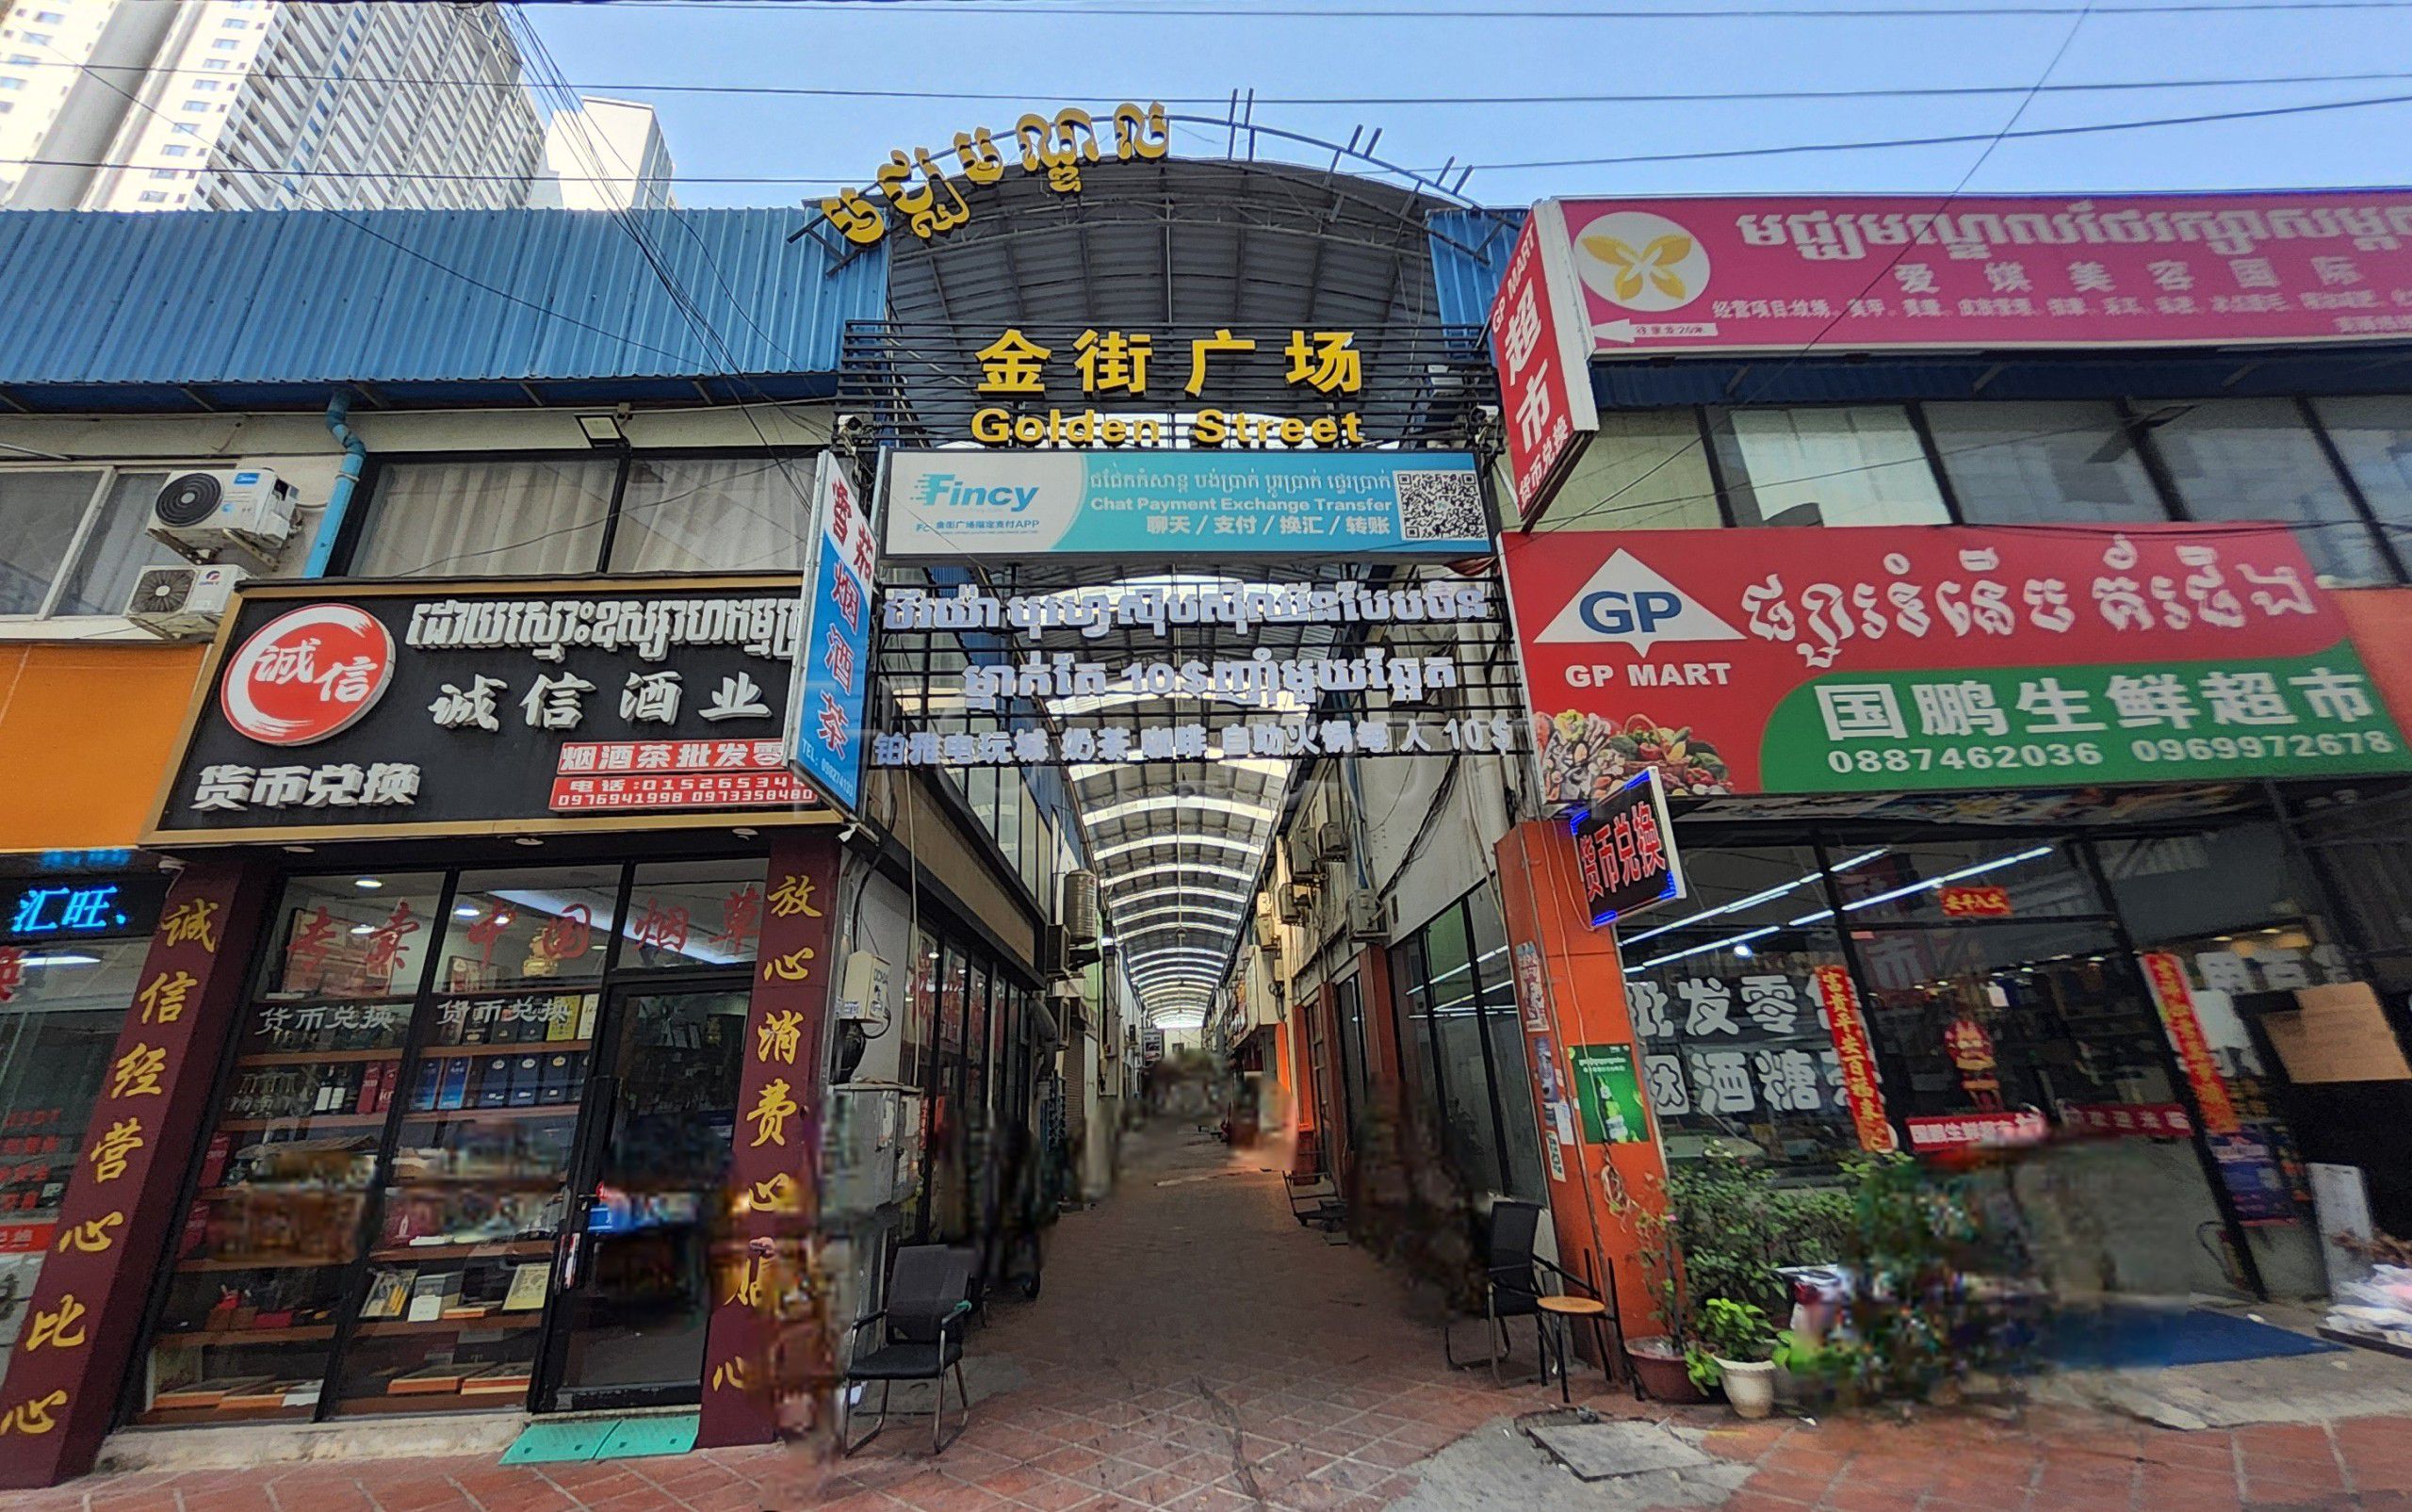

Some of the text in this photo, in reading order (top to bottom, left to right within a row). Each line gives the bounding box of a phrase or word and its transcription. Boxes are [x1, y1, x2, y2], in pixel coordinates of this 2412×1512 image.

[1508, 222, 1535, 301] MART
[974, 328, 1363, 396] 金街广场
[1505, 277, 1551, 454] 超市
[970, 408, 1364, 446] Golden Street
[921, 473, 1039, 512] Fincy
[1090, 496, 1393, 514] Chat Payment Exchange Transfer
[1146, 514, 1191, 535] 聊天
[1213, 514, 1258, 535] 支付
[1279, 515, 1324, 535] 换汇
[1345, 515, 1392, 535] 转账
[1579, 590, 1683, 635] GP
[1564, 661, 1732, 689] GP MART
[429, 671, 776, 735] 诚信酒业
[1814, 668, 2373, 743] 国鹏生鲜超市
[1060, 725, 1131, 762] 奶茶
[1140, 723, 1208, 761] 咖啡
[1827, 730, 2396, 774] 0887462036 0969972678
[188, 761, 423, 813] 货币兑换
[558, 791, 683, 807] 0976941998
[1578, 800, 1668, 902] 货币兑换
[253, 1003, 399, 1036] 货币兑换
[435, 995, 573, 1027] 货币兑换
[1643, 1048, 1886, 1116] 烟酒糖
